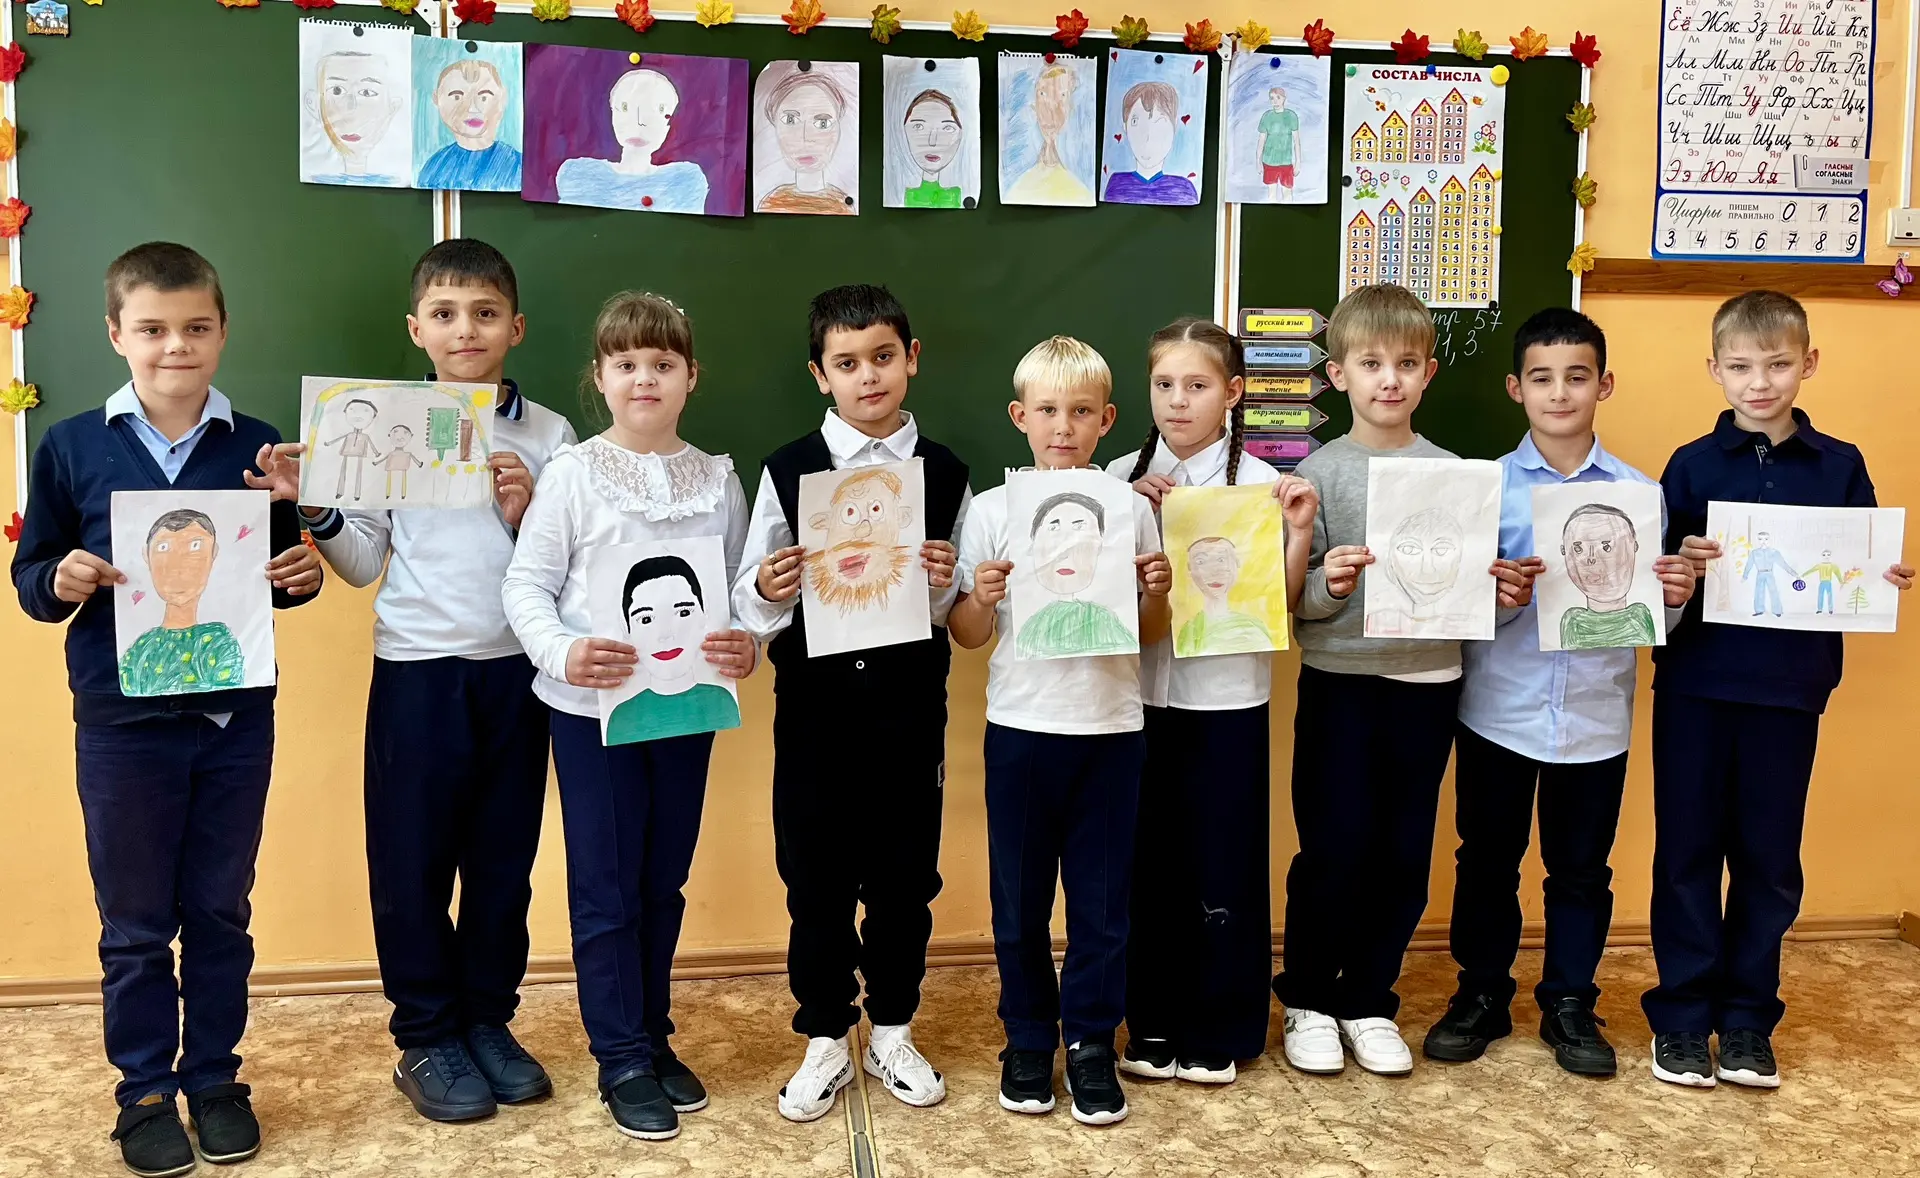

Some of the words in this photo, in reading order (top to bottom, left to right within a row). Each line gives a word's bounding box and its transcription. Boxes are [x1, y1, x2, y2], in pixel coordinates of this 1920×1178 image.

[1669, 7, 1691, 31] Ёё
[1697, 10, 1740, 32] Жж
[1748, 12, 1767, 41] Зз
[1779, 14, 1802, 34] Ии
[1812, 11, 1836, 36] Йй
[1846, 16, 1869, 37] Кк
[1857, 41, 1867, 50] Рр
[1666, 48, 1697, 68] Лл
[1703, 49, 1743, 70] Мм
[1750, 50, 1776, 71] Нн
[1785, 51, 1804, 72] Оо
[1810, 51, 1837, 73] Пп
[1844, 52, 1866, 80] Рр
[1372, 70, 1428, 80] СОСТАВ
[1434, 71, 1482, 82] ЧИСЛА
[1759, 74, 1768, 83] Уу
[1790, 76, 1804, 85] Фф
[1667, 84, 1686, 105] Сс
[1694, 84, 1732, 106] Тт
[1740, 86, 1761, 116] Уу
[1768, 86, 1796, 116] Фф
[1802, 87, 1834, 108] Хх
[1842, 89, 1866, 115] Цц
[1668, 122, 1690, 144] Чч
[1703, 123, 1741, 144] Шш
[1753, 124, 1792, 151] Щщ
[1667, 160, 1691, 182] Ээ
[1701, 161, 1737, 182] Юю
[1749, 161, 1778, 184] Яя
[1664, 197, 1722, 228] Цифры
[1783, 203, 1796, 221] 0
[1817, 203, 1828, 221] 1
[1848, 204, 1859, 222] 2
[1664, 231, 1675, 247] 3
[1697, 231, 1706, 248] 4
[1725, 232, 1737, 249] 5
[1755, 233, 1768, 249] 6
[1788, 233, 1797, 250] 7
[1815, 234, 1827, 250] 8
[1846, 234, 1857, 251] 9
[1474, 310, 1503, 332] 57
